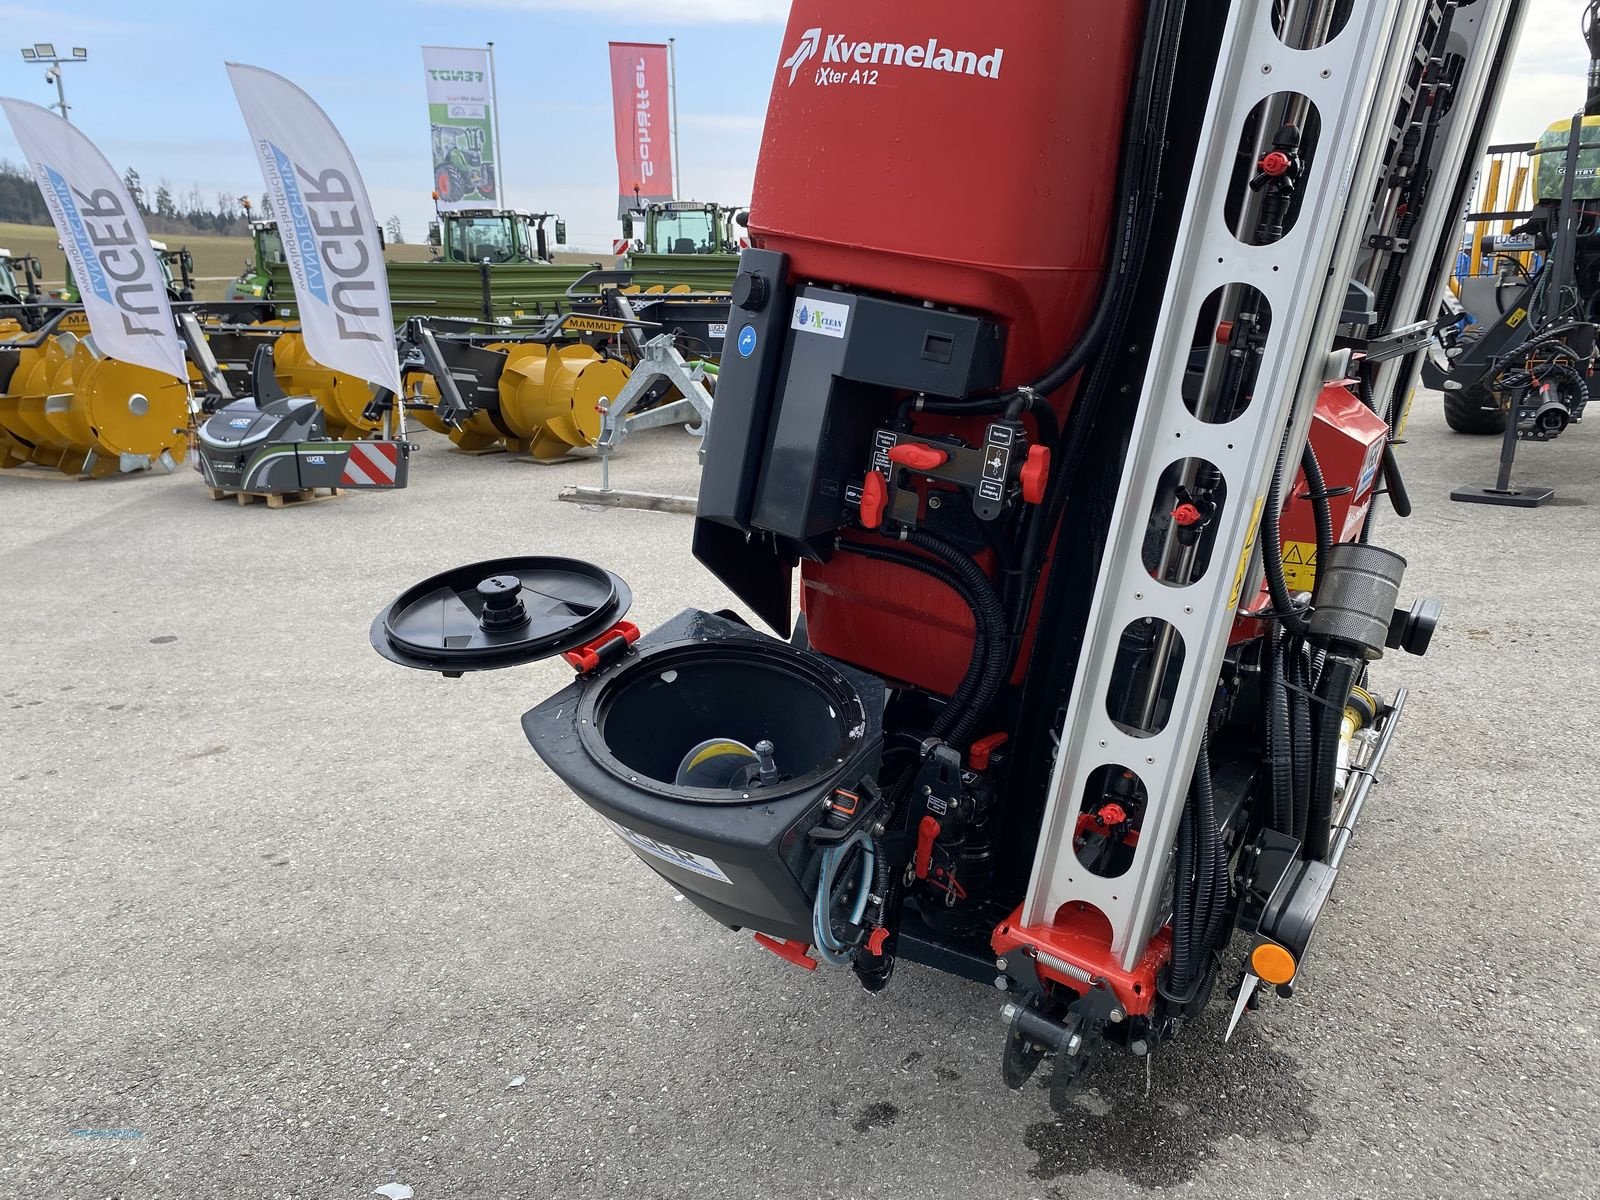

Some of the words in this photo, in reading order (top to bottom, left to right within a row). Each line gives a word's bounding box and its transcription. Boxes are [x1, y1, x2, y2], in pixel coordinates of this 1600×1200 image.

[821, 34, 1004, 79] Kverneland
[815, 67, 848, 86] iXter
[849, 70, 879, 85] A12
[1494, 235, 1530, 245] LUGER
[569, 318, 618, 331] MAMMUT
[709, 324, 726, 332] LUGER
[229, 417, 252, 426] LUGER
[306, 456, 325, 464] LUGER
